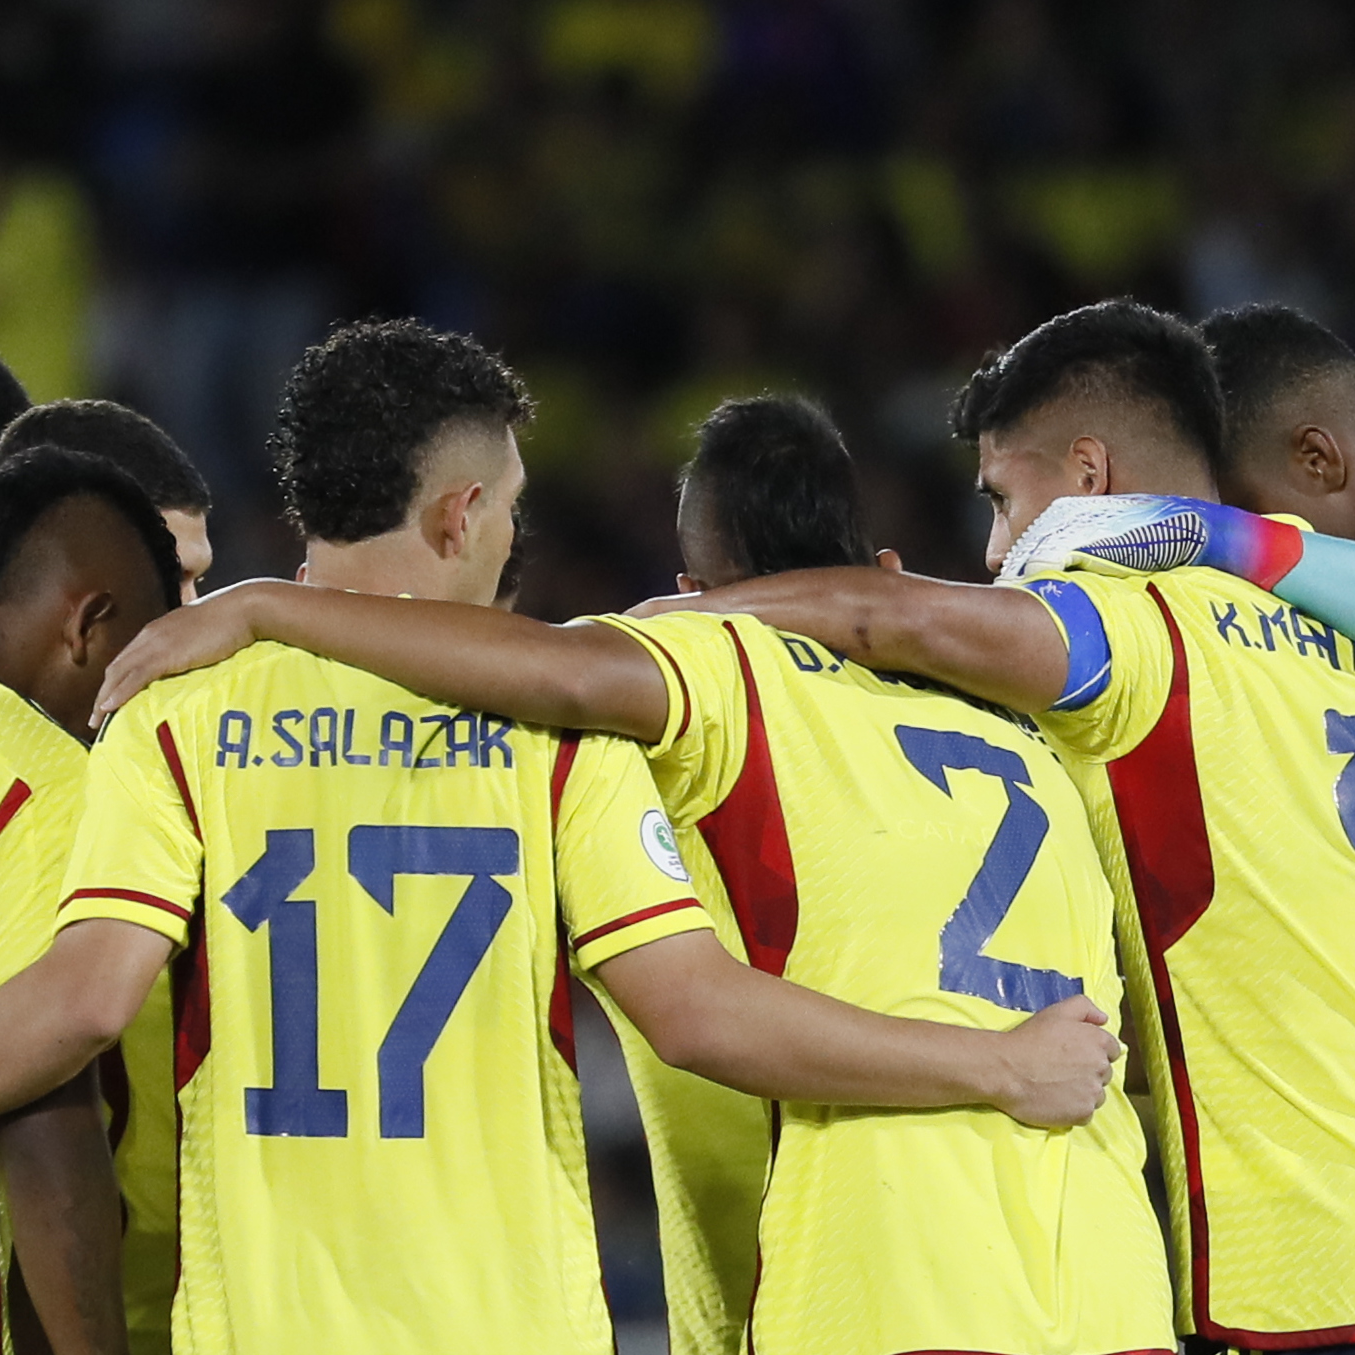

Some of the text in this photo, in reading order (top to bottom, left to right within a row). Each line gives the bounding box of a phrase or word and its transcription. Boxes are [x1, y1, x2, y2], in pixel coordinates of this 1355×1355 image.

[215, 706, 515, 769] A.SALAZAR
[894, 723, 1085, 1014] 2
[220, 825, 520, 1139] 17
